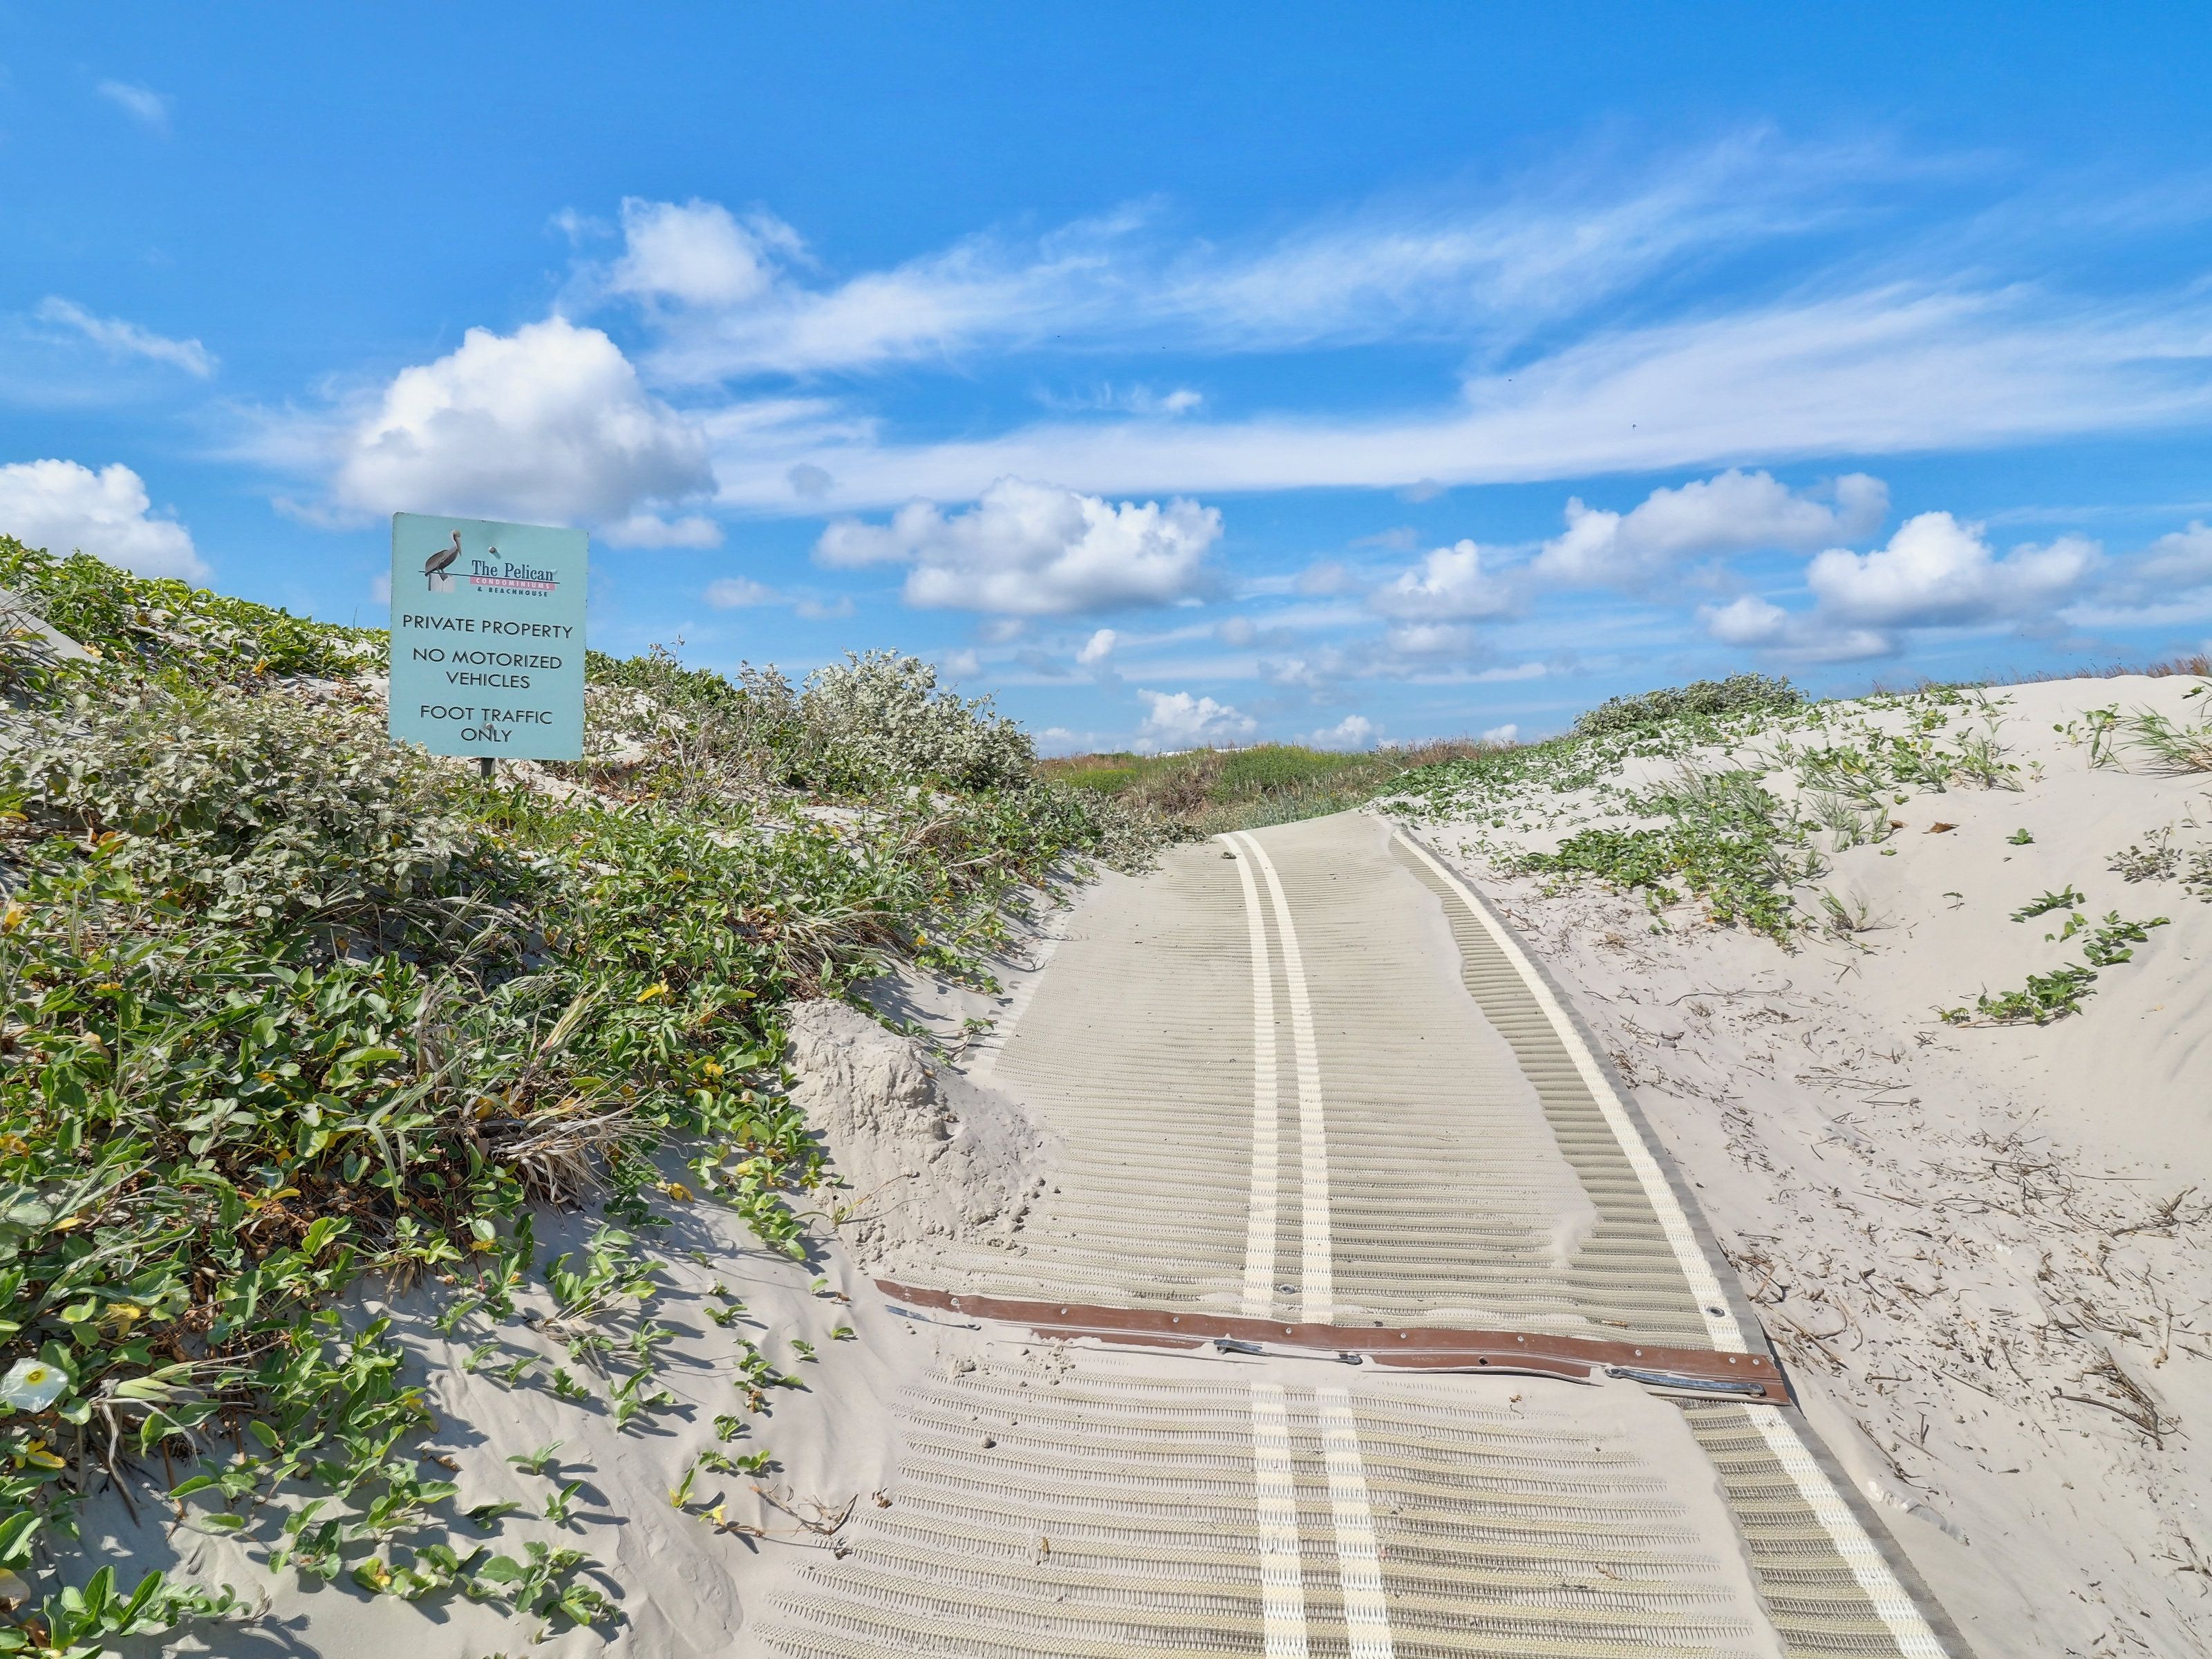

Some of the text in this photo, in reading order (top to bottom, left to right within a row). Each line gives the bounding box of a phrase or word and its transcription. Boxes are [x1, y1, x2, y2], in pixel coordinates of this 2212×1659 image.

[472, 560, 554, 581] The Pelican
[476, 579, 550, 589] CONDOMINIUMS
[489, 588, 547, 597] BEACHHOUSE
[403, 615, 573, 639] PRIVATE PROPERTY
[413, 648, 562, 668] NO MOTORIZED
[446, 671, 530, 688] VEHICLES
[421, 706, 552, 724] FOOT TRAFFIC
[461, 729, 513, 742] ONLY
